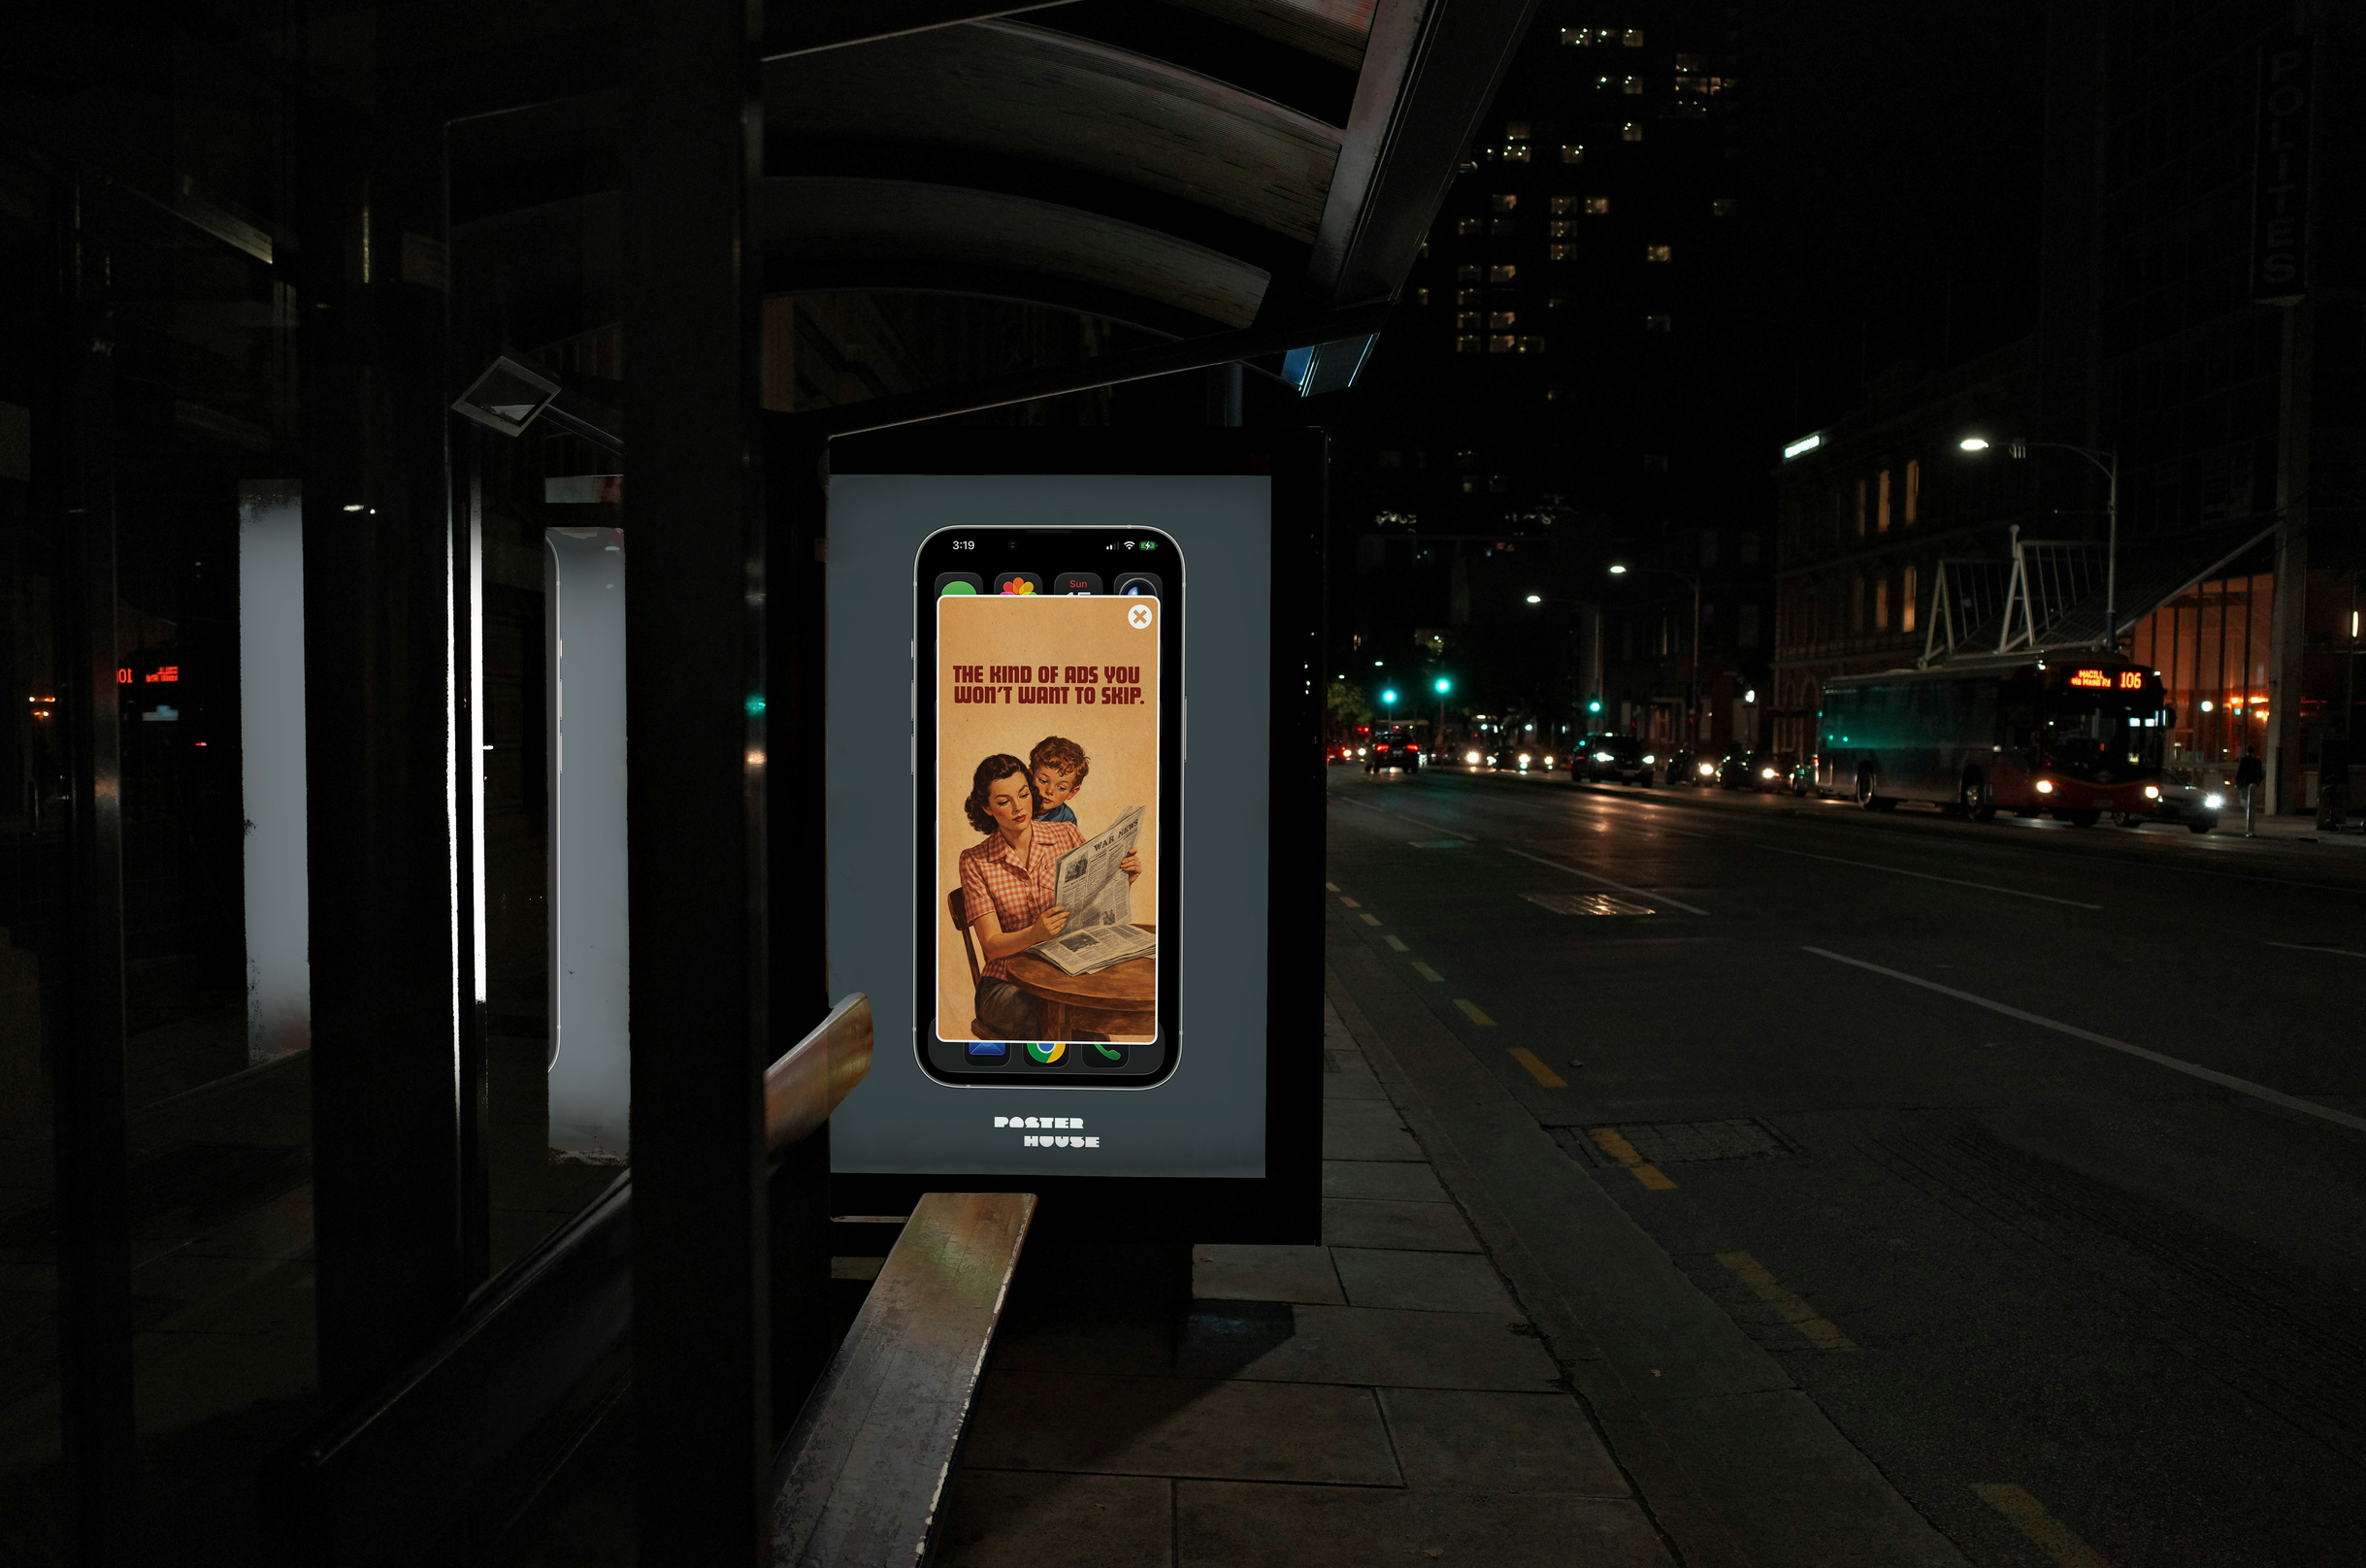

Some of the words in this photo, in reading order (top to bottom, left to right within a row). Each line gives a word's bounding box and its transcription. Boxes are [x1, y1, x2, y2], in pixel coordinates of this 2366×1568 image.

[2262, 50, 2304, 284] POLITES
[952, 540, 975, 550] 3:19
[1069, 579, 1088, 588] Sun
[953, 665, 984, 683] THE
[989, 666, 1033, 684] KIND
[1037, 666, 1059, 684] OF
[1065, 666, 1099, 684] ADS
[1103, 666, 1140, 684] YOU
[2120, 671, 2142, 689] 106
[954, 686, 1013, 704] WON'T
[1018, 686, 1070, 704] WANT
[1074, 686, 1097, 704] TO
[1101, 687, 1145, 705] SKIP.
[1093, 834, 1115, 852] WAR
[1117, 818, 1139, 839] NEWS
[994, 1116, 1085, 1129] POSTER
[1023, 1135, 1101, 1148] HOUSE
